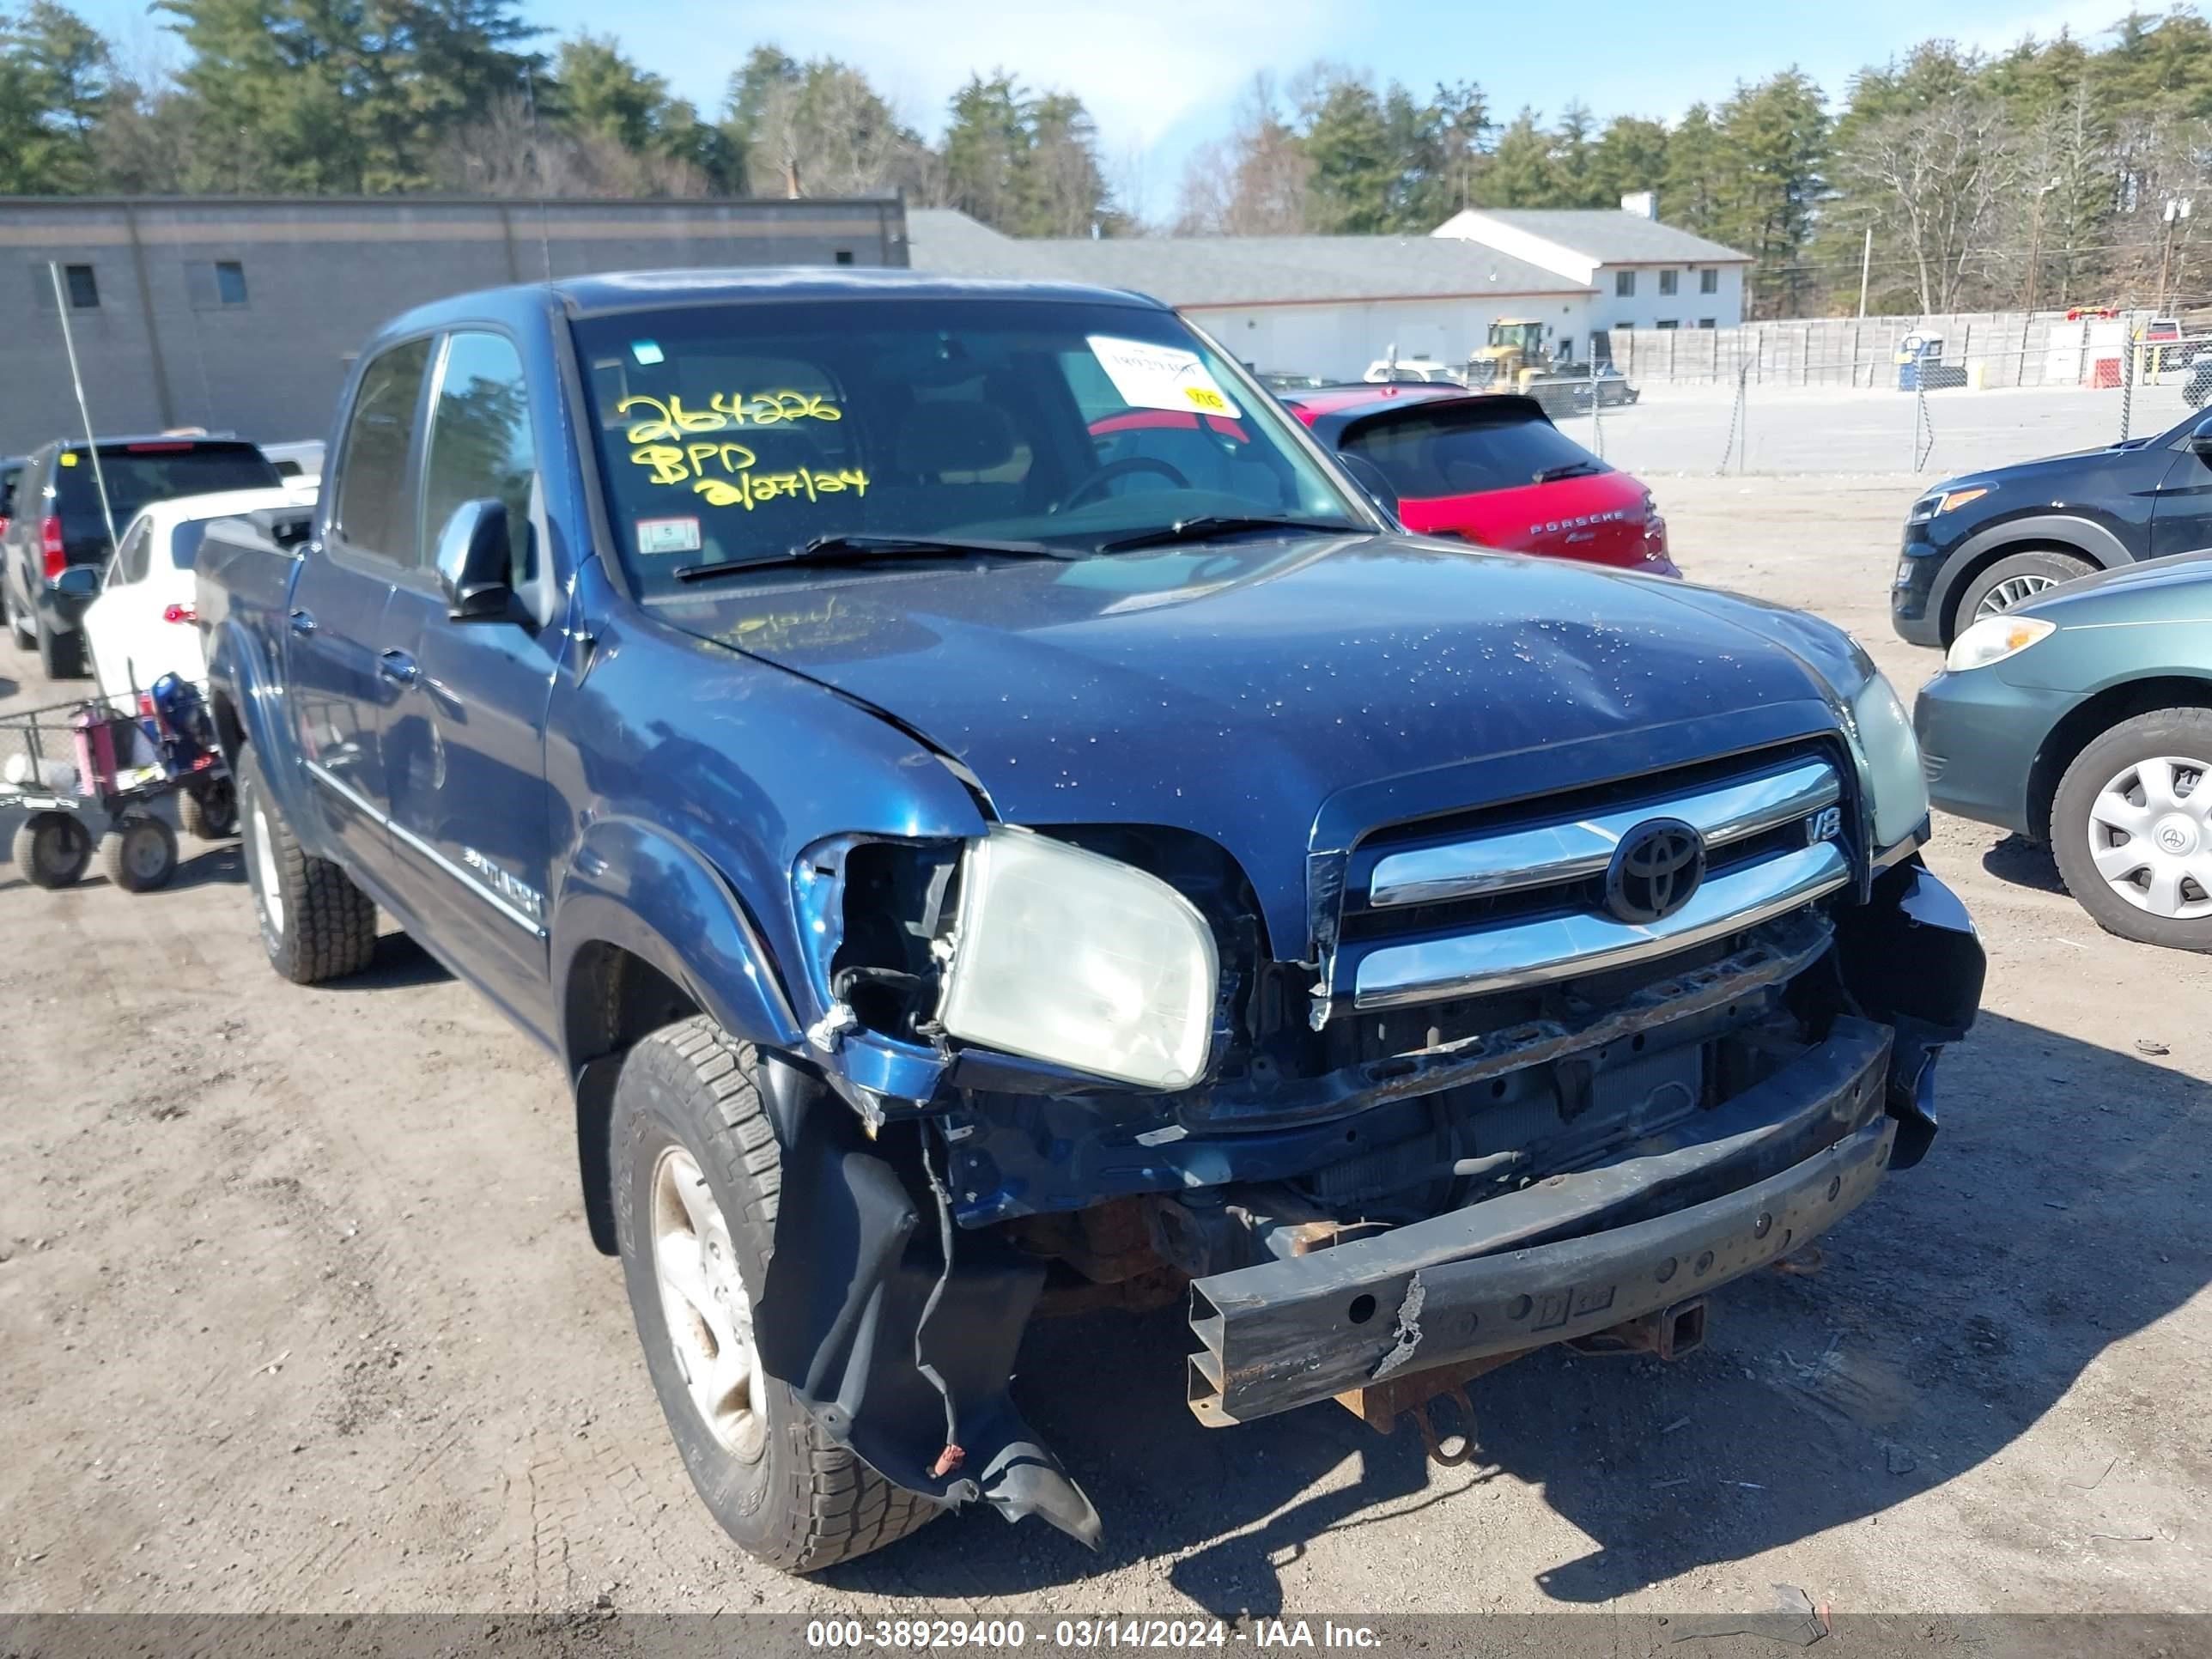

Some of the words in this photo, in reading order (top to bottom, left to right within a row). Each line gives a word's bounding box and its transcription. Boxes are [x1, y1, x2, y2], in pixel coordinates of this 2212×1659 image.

[617, 392, 842, 444] 264226
[694, 469, 869, 511] 2/27/24
[1531, 511, 1623, 534] PORSCHE
[1805, 807, 1841, 847] V8
